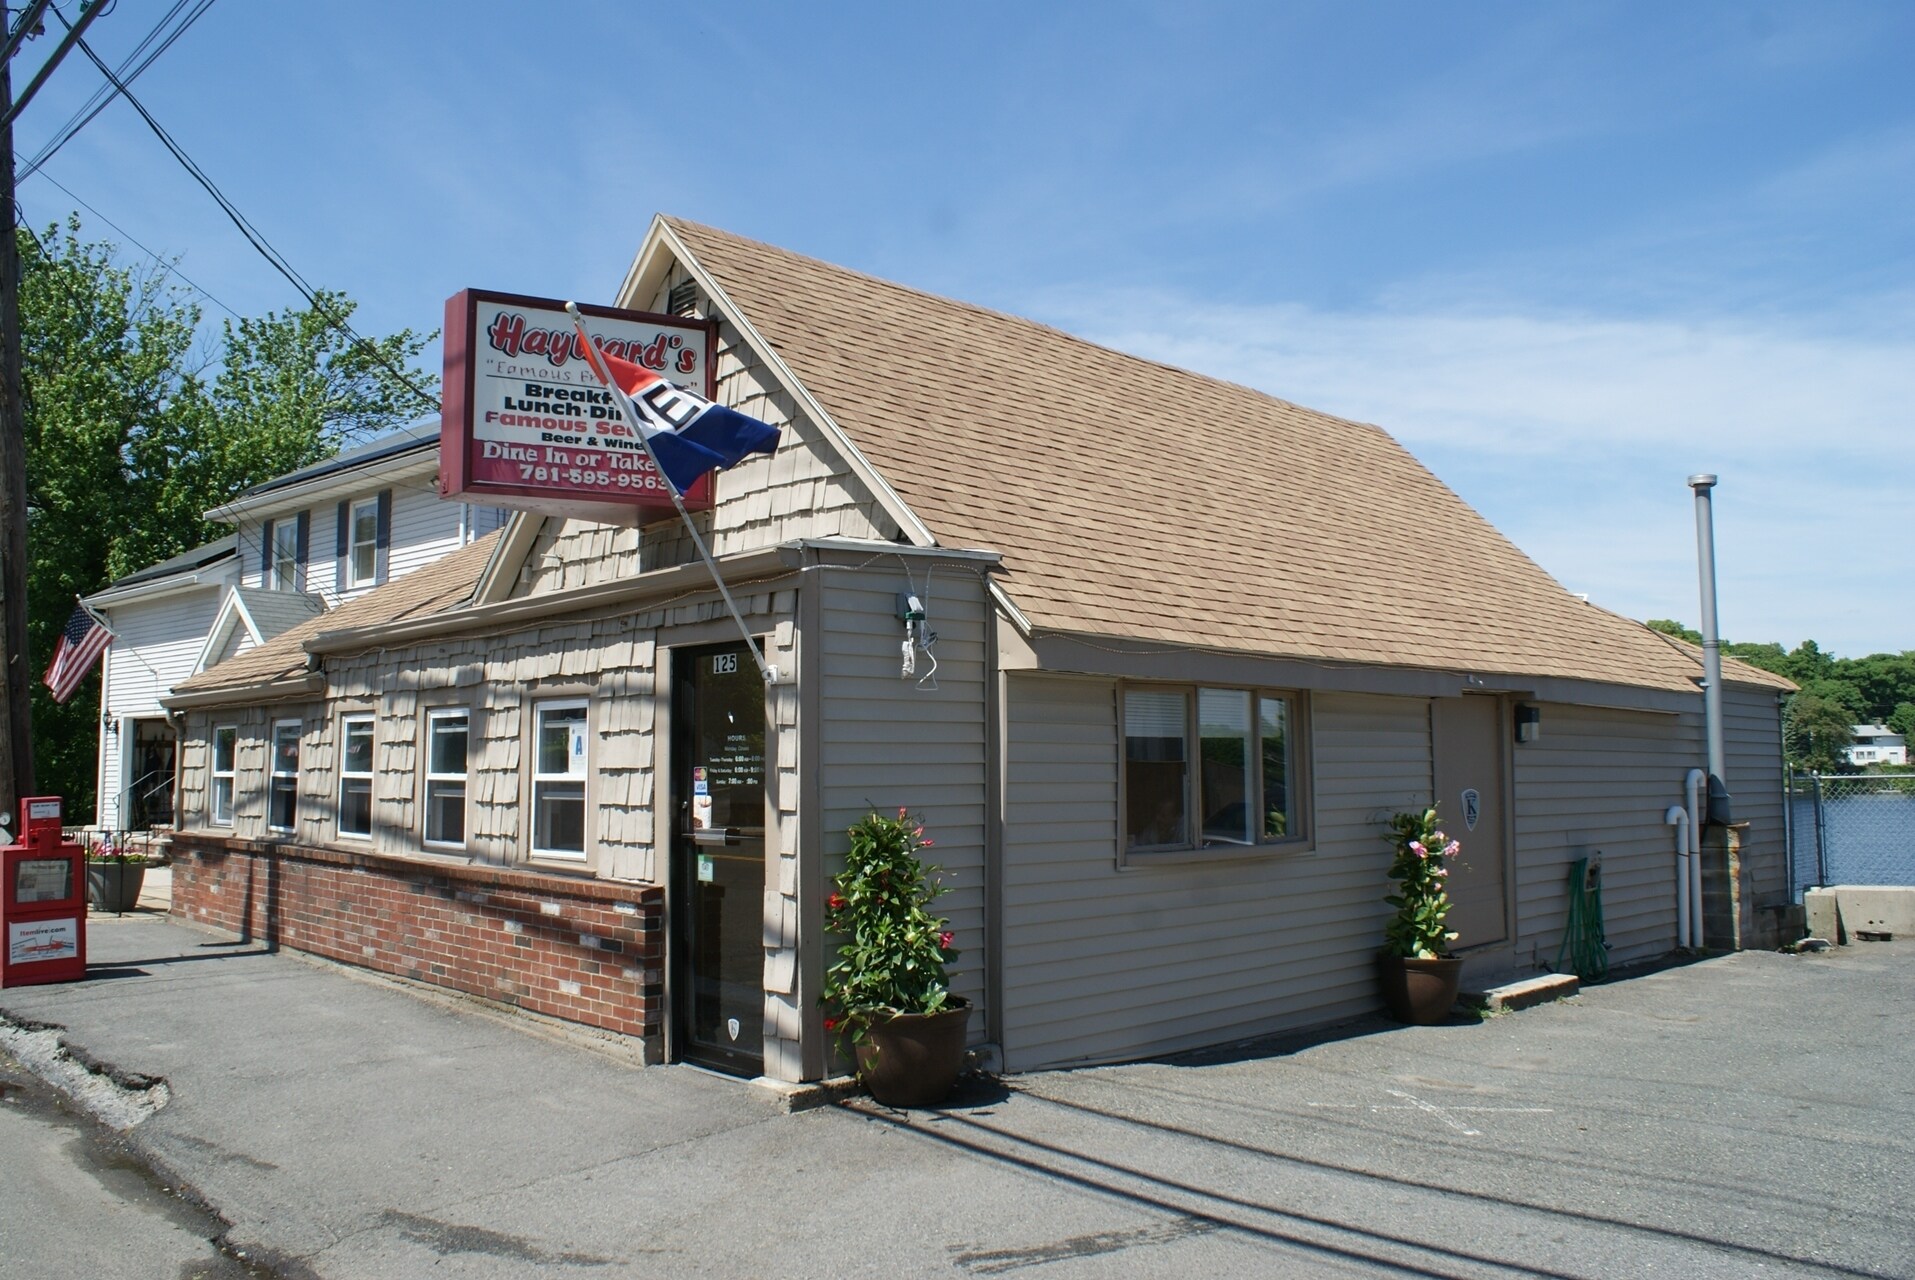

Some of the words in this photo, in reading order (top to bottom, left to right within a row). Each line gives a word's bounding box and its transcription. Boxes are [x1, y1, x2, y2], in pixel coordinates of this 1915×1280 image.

[487, 312, 698, 374] Hayward's
[525, 384, 617, 405] Breakf
[485, 411, 588, 433] Famous
[541, 433, 582, 445] Beer
[586, 437, 599, 447] &
[482, 441, 538, 463] Dine
[545, 447, 569, 465] In
[575, 454, 602, 467] or
[715, 654, 735, 672] 125
[1467, 799, 1477, 815] K
